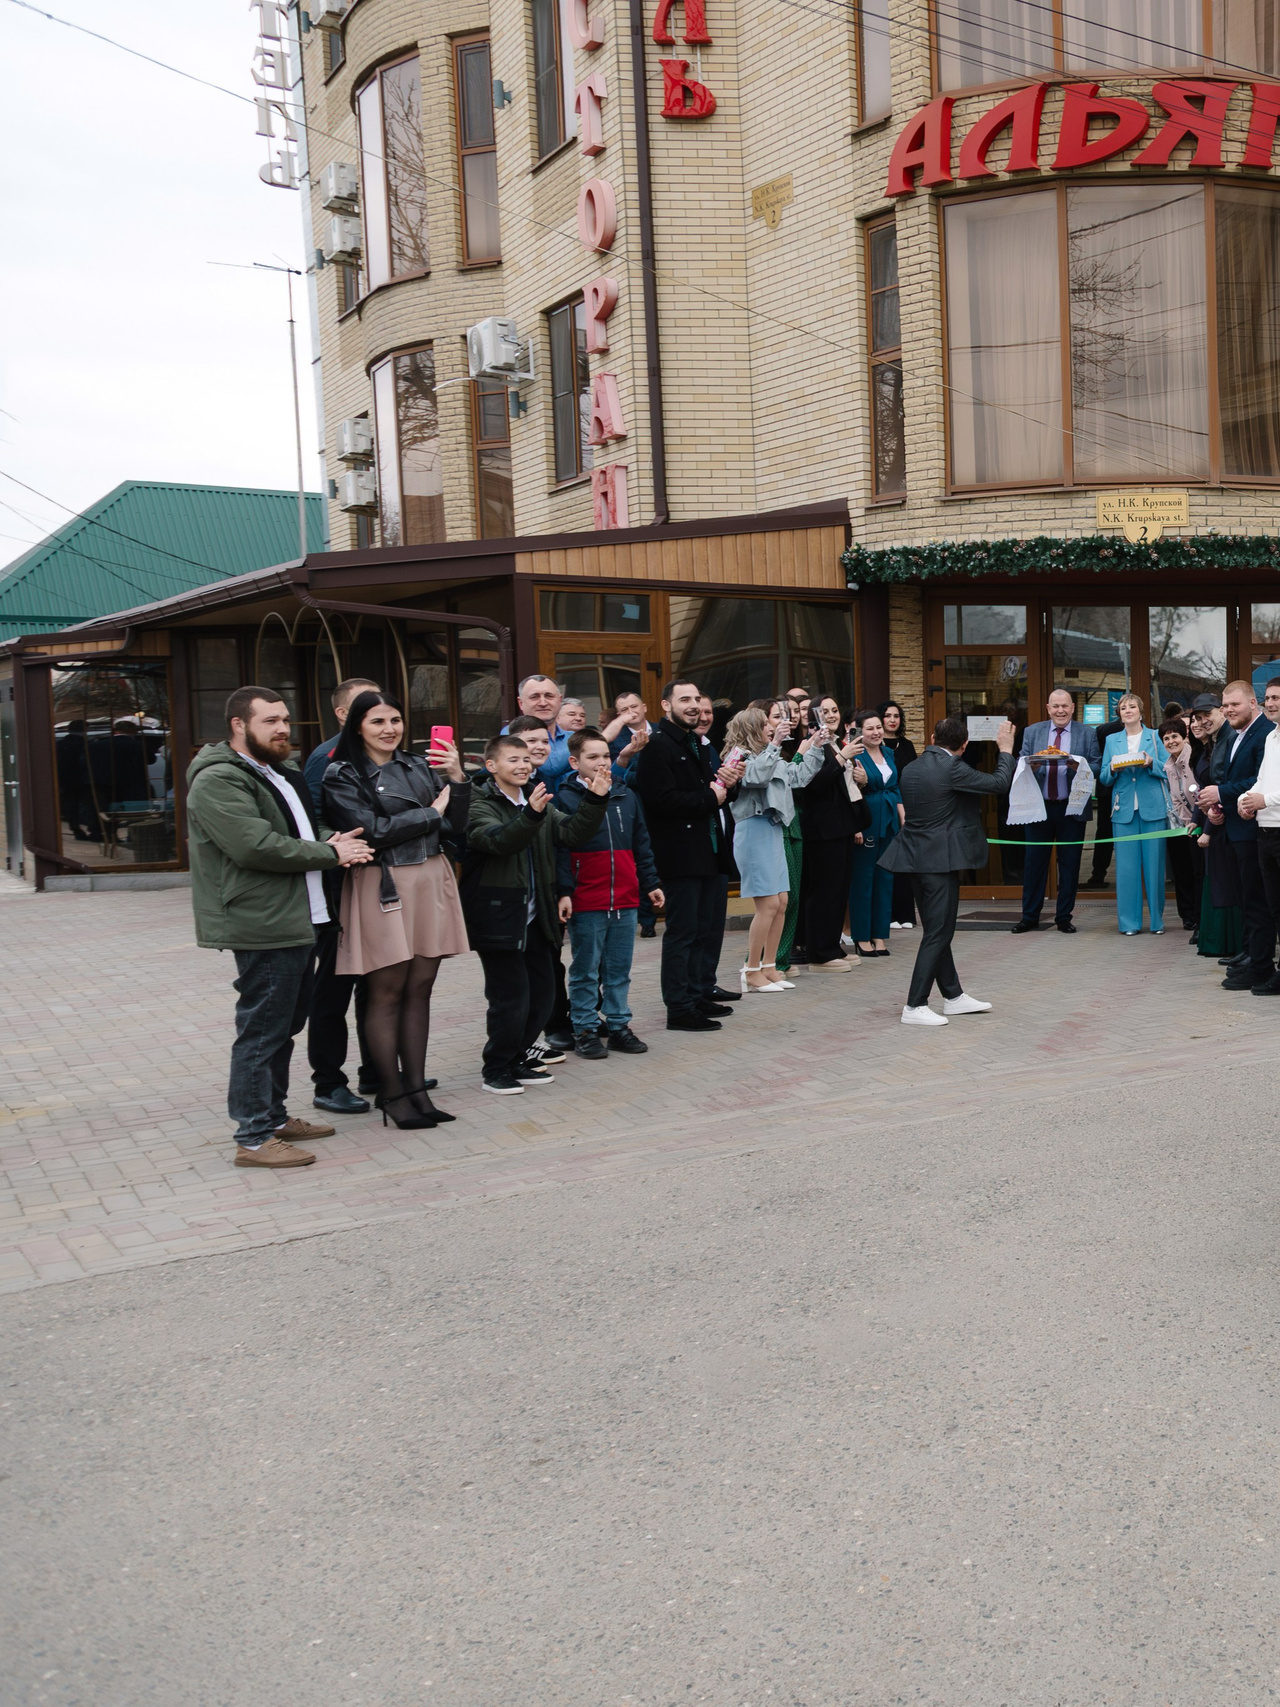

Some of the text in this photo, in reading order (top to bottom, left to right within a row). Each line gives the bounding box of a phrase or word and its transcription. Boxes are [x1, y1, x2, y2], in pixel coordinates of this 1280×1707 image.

[1102, 497, 1183, 510] ул. Н.К. Крупской
[1102, 513, 1184, 524] N.K. Krupskaya st.
[1139, 526, 1148, 541] 2
